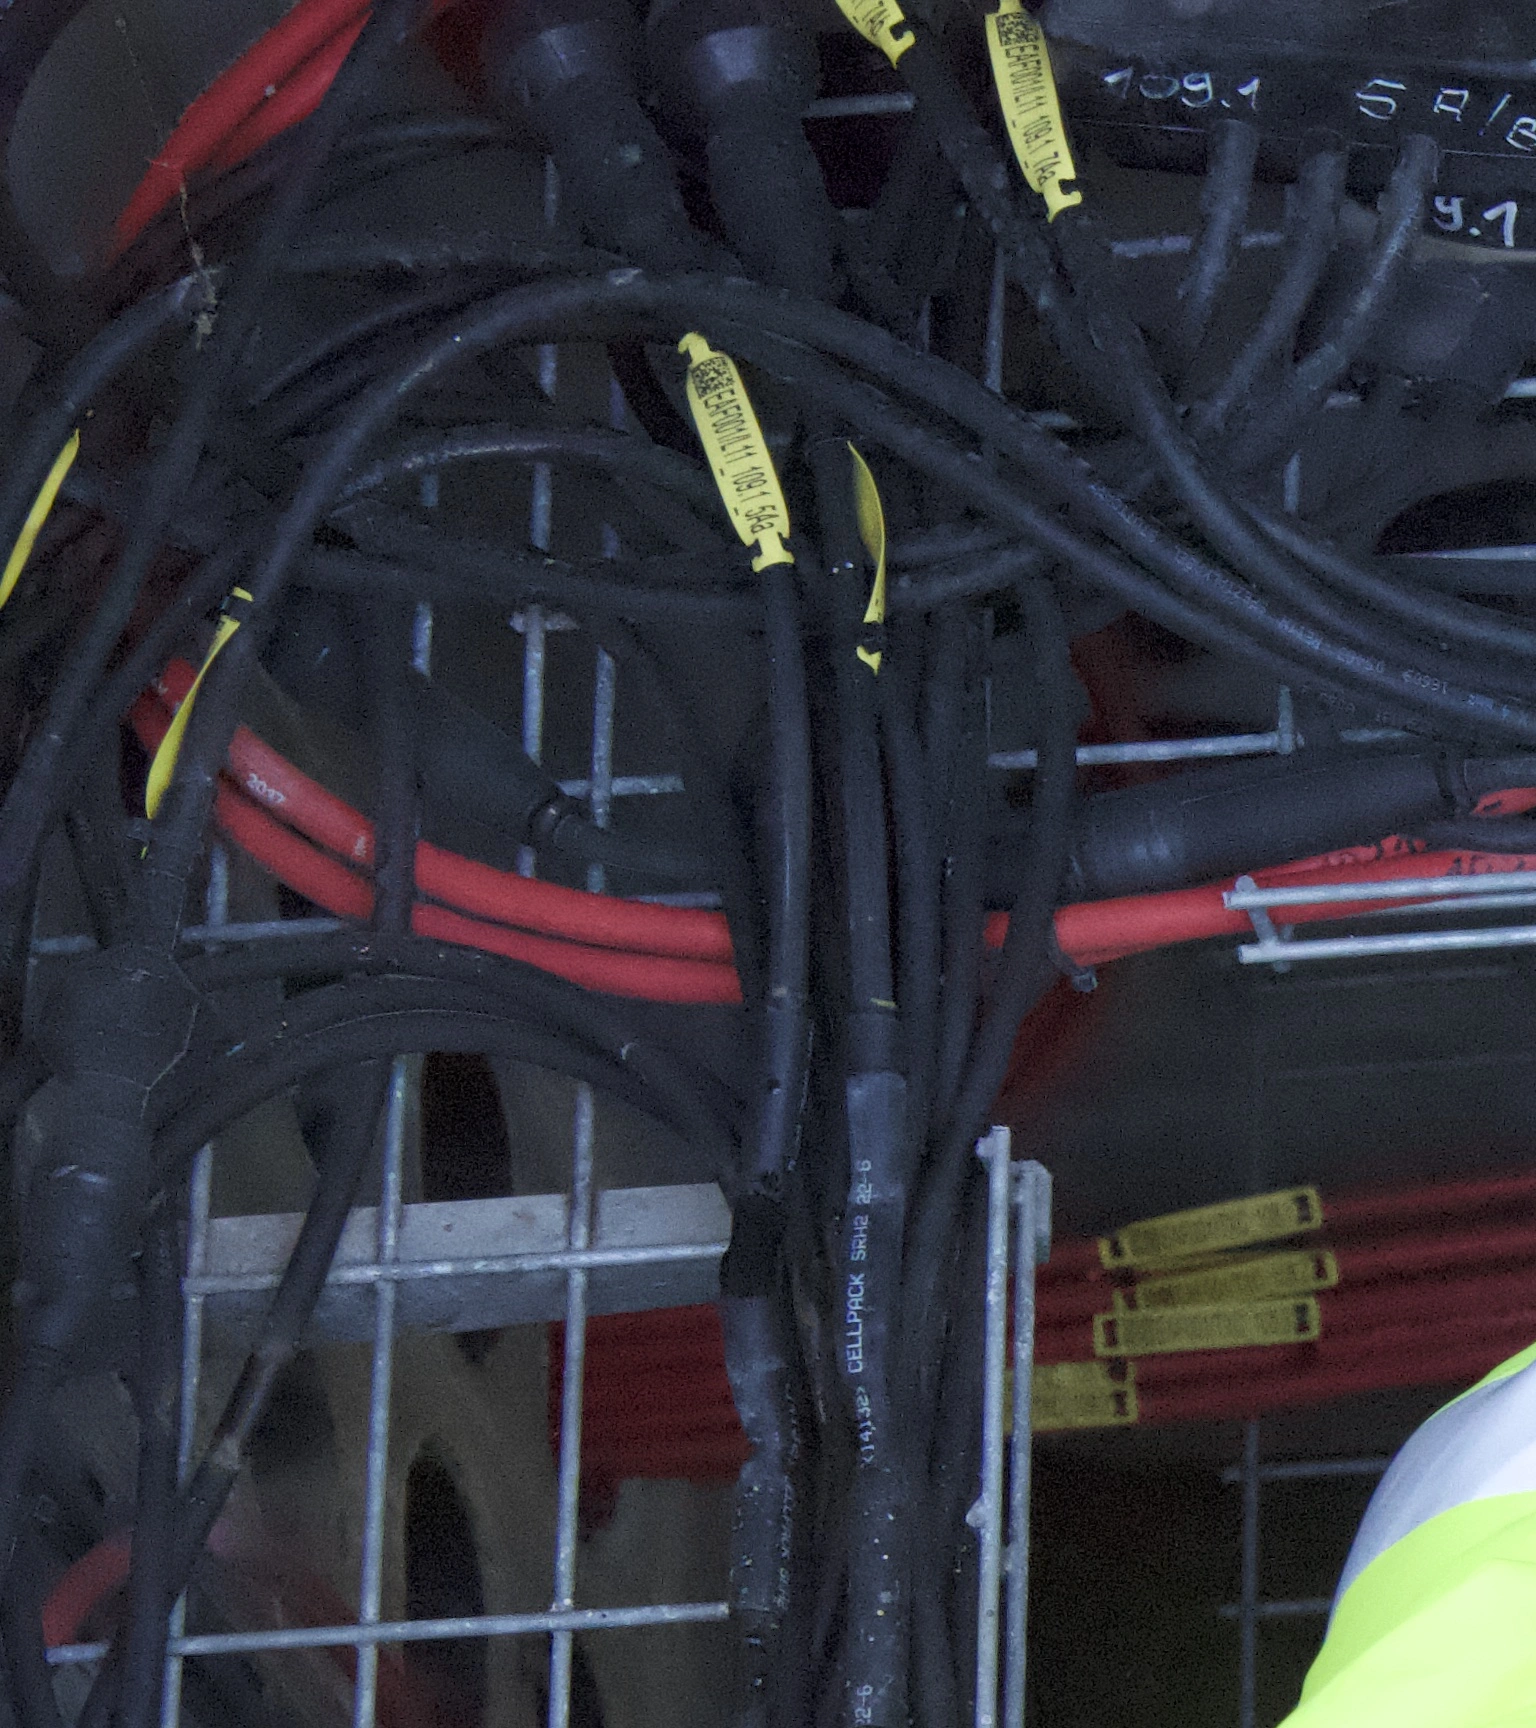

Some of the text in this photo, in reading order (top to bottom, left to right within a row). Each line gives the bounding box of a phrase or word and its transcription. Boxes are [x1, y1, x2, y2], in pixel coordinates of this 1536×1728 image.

[1102, 65, 1261, 113] 109.1
[702, 390, 778, 535] EAF001/L11_109.1_5Aa
[854, 1158, 874, 1205] 22-6
[849, 1214, 870, 1261] SRH2
[844, 1273, 869, 1374] CELLPACK
